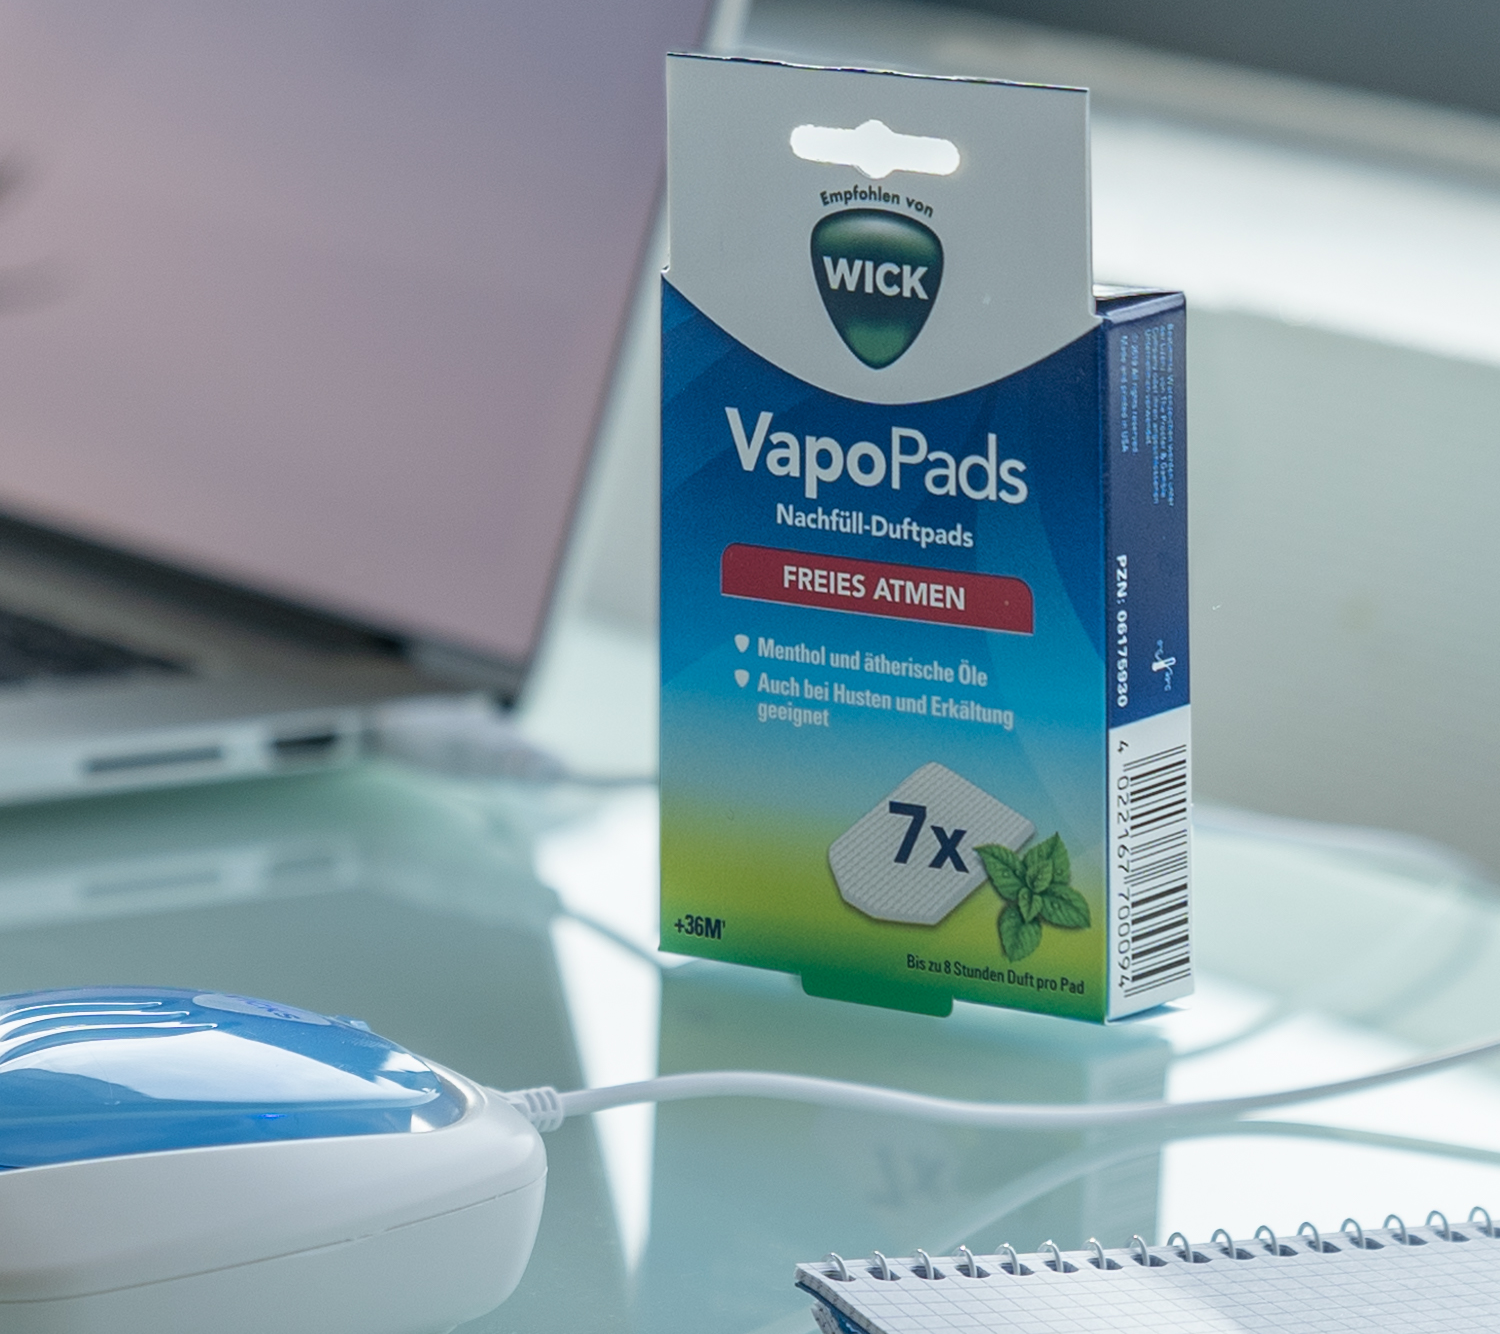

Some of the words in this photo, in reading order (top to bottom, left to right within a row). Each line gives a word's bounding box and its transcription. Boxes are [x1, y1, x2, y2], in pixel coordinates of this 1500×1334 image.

[820, 184, 901, 206] Empfohlen
[906, 196, 934, 218] von
[823, 255, 930, 300] WICK
[725, 407, 1028, 504] VapoPads
[776, 503, 974, 548] Nachfüll-Duftpads
[783, 565, 866, 598] FREIES
[873, 578, 966, 611] ATMEN
[1116, 554, 1128, 604] PZN:
[758, 637, 826, 665] Menthol
[830, 651, 860, 671] und
[864, 652, 955, 683] ätherische
[958, 659, 988, 687] Öle
[1117, 610, 1129, 708] 06175930
[757, 672, 800, 697] Auch
[804, 679, 829, 702] bei
[833, 683, 892, 710] Husten
[896, 695, 927, 716] und
[931, 696, 1014, 731] Erkältung
[757, 702, 830, 728] geeignet
[889, 800, 969, 874] 7x
[907, 954, 926, 971] Bis
[928, 961, 942, 973] zu
[944, 960, 951, 974] 8
[954, 961, 1004, 983] Stunden
[1008, 969, 1034, 987] Duft
[1037, 978, 1057, 992] pro
[1061, 977, 1085, 994] Pad
